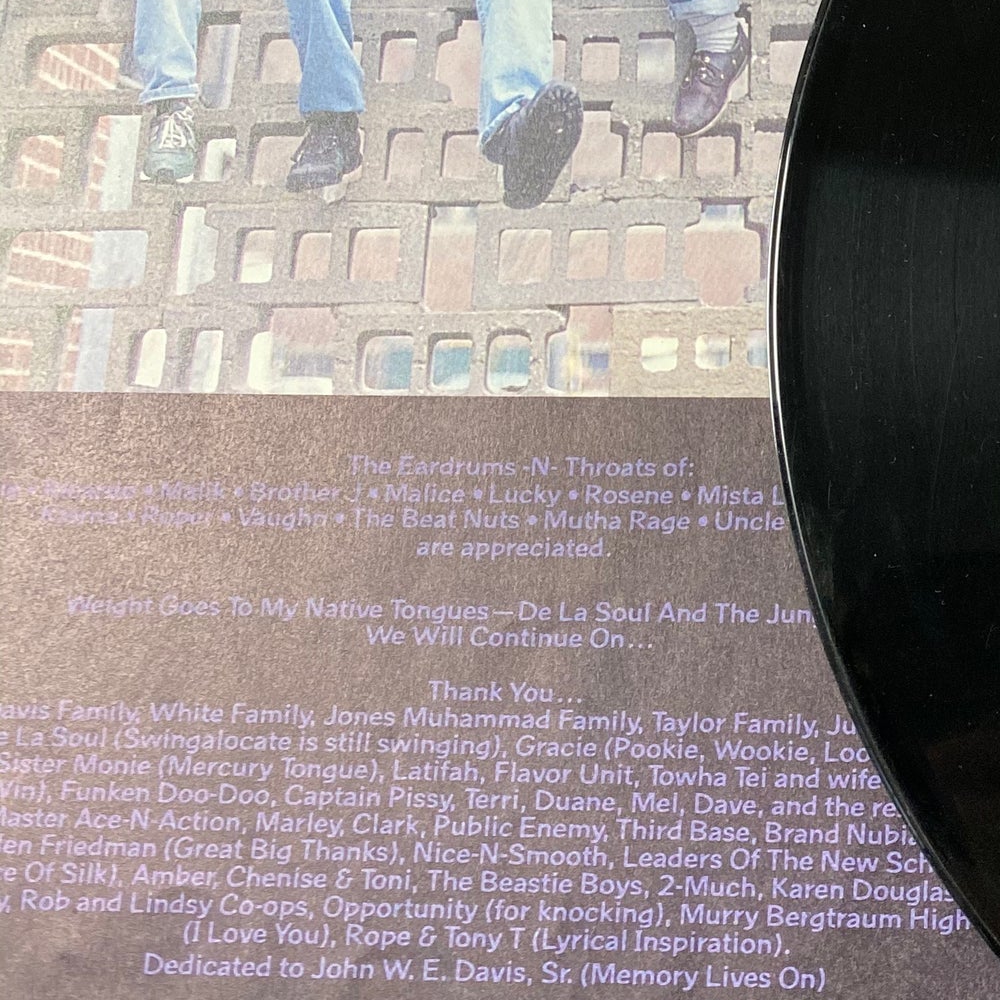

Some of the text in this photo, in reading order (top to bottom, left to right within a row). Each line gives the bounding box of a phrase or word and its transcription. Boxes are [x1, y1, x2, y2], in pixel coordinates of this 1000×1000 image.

[349, 453, 392, 475] The
[397, 454, 516, 478] Eardrums
[565, 455, 656, 478] Throats
[662, 456, 694, 478] of:
[416, 534, 611, 563] are appreciated.
[365, 623, 405, 645] We
[412, 624, 462, 646] Will
[469, 625, 582, 649] Continue
[428, 679, 503, 702] Thank
[40, 833, 157, 857] Friedman
[164, 836, 244, 863] (Great
[250, 837, 292, 864] Big
[301, 838, 406, 865] Thanks),
[412, 840, 614, 870] Nice-N-Smooth,
[623, 845, 723, 869] Leaders
[729, 847, 761, 870] Of
[767, 848, 813, 871] The
[820, 849, 879, 873] New
[24, 860, 55, 883] Of
[131, 863, 219, 889] Amber,
[226, 865, 327, 889] Chenise
[335, 868, 353, 889] &
[360, 868, 418, 893] Toni,
[427, 869, 473, 892] The
[480, 870, 573, 894] Beastie
[580, 872, 650, 899] Boys,
[657, 874, 764, 900] 2-Much,
[771, 877, 844, 900] Karen
[20, 888, 971, 936] Rob and Lindsy Co-ops, Opportunity (for knocking), Murry Bergtraum High
[208, 921, 267, 944] Love
[274, 921, 337, 948] You),
[344, 923, 411, 951] Rope
[418, 925, 438, 947] &
[443, 925, 503, 953] Tony
[509, 926, 526, 949] T
[531, 927, 626, 956] (Lyrical
[634, 929, 791, 959] Inspiration).
[143, 952, 826, 992] Dedicated to John W. E. Davis, Sr. (Memory Lives On)
